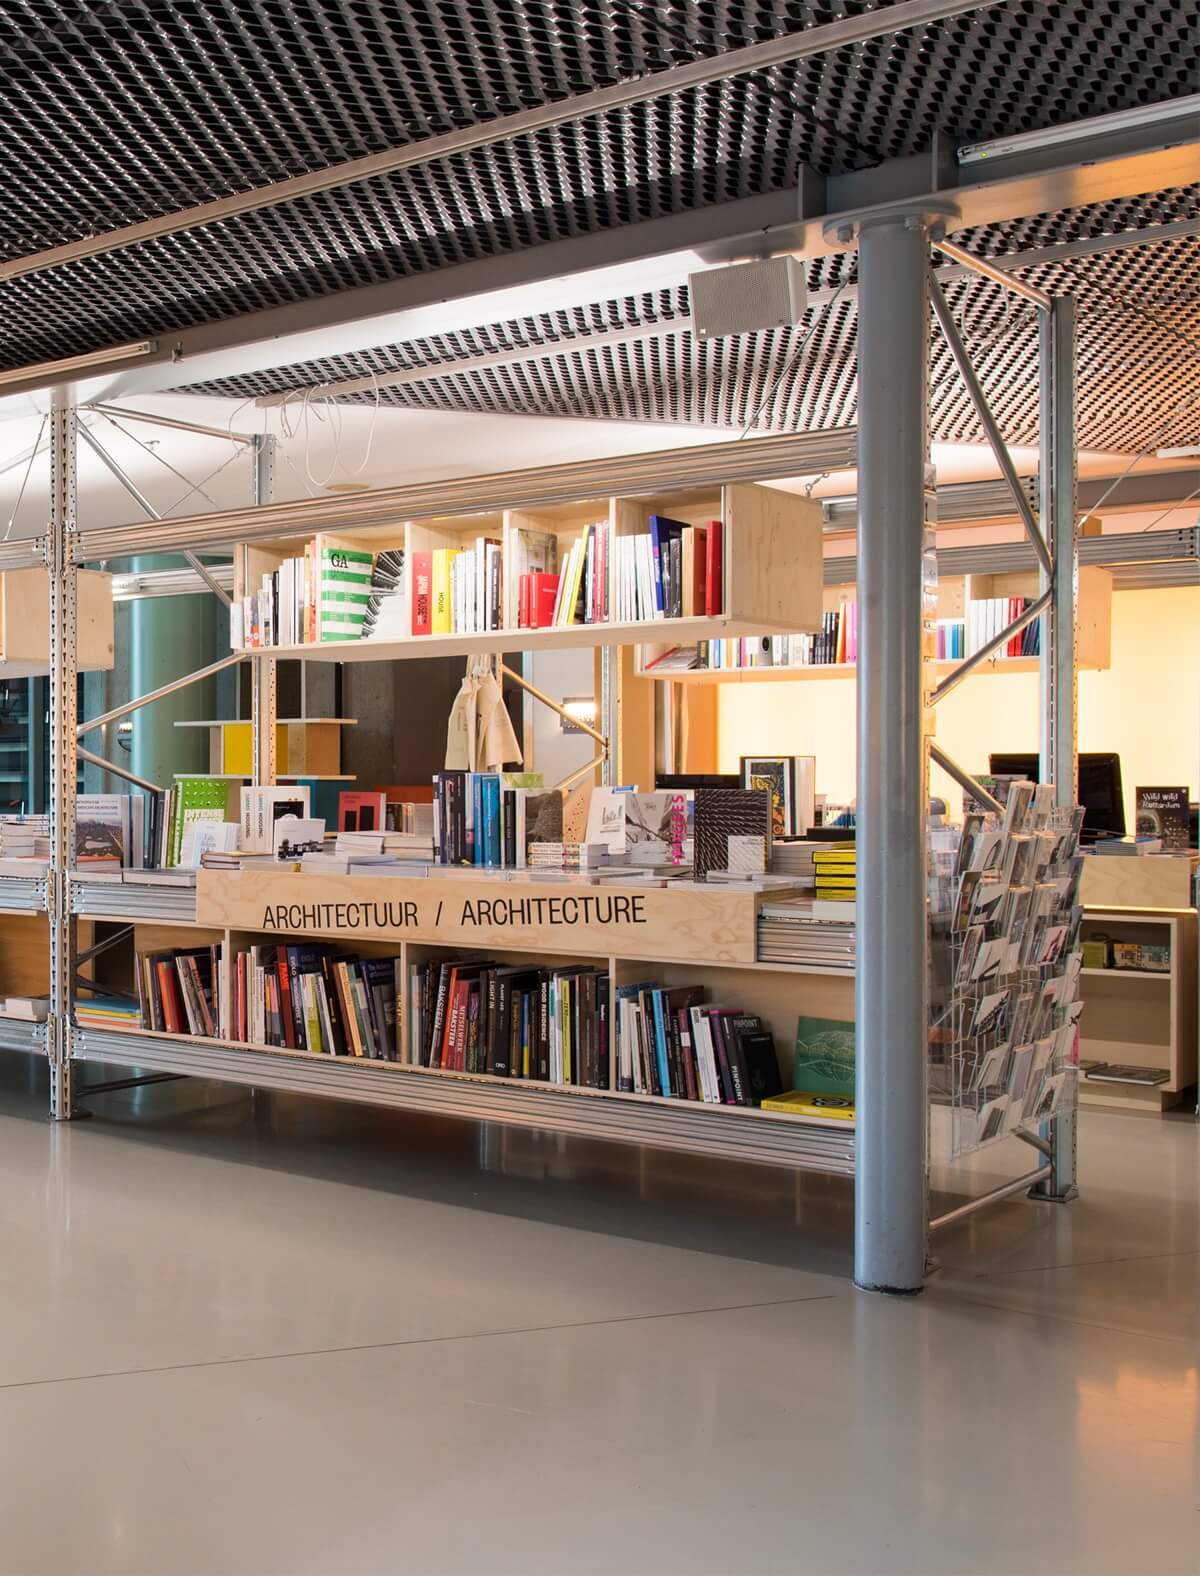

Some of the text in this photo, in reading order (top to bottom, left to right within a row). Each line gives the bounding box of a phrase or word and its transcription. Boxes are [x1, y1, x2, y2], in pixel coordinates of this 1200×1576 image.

[330, 553, 348, 568] GA
[1161, 793, 1179, 801] wild
[263, 895, 647, 929] ARCHITECTUUR / ARCHITECTURE
[448, 1008, 459, 1046] BAKSTEEN
[730, 1065, 743, 1101] PINPOINT
